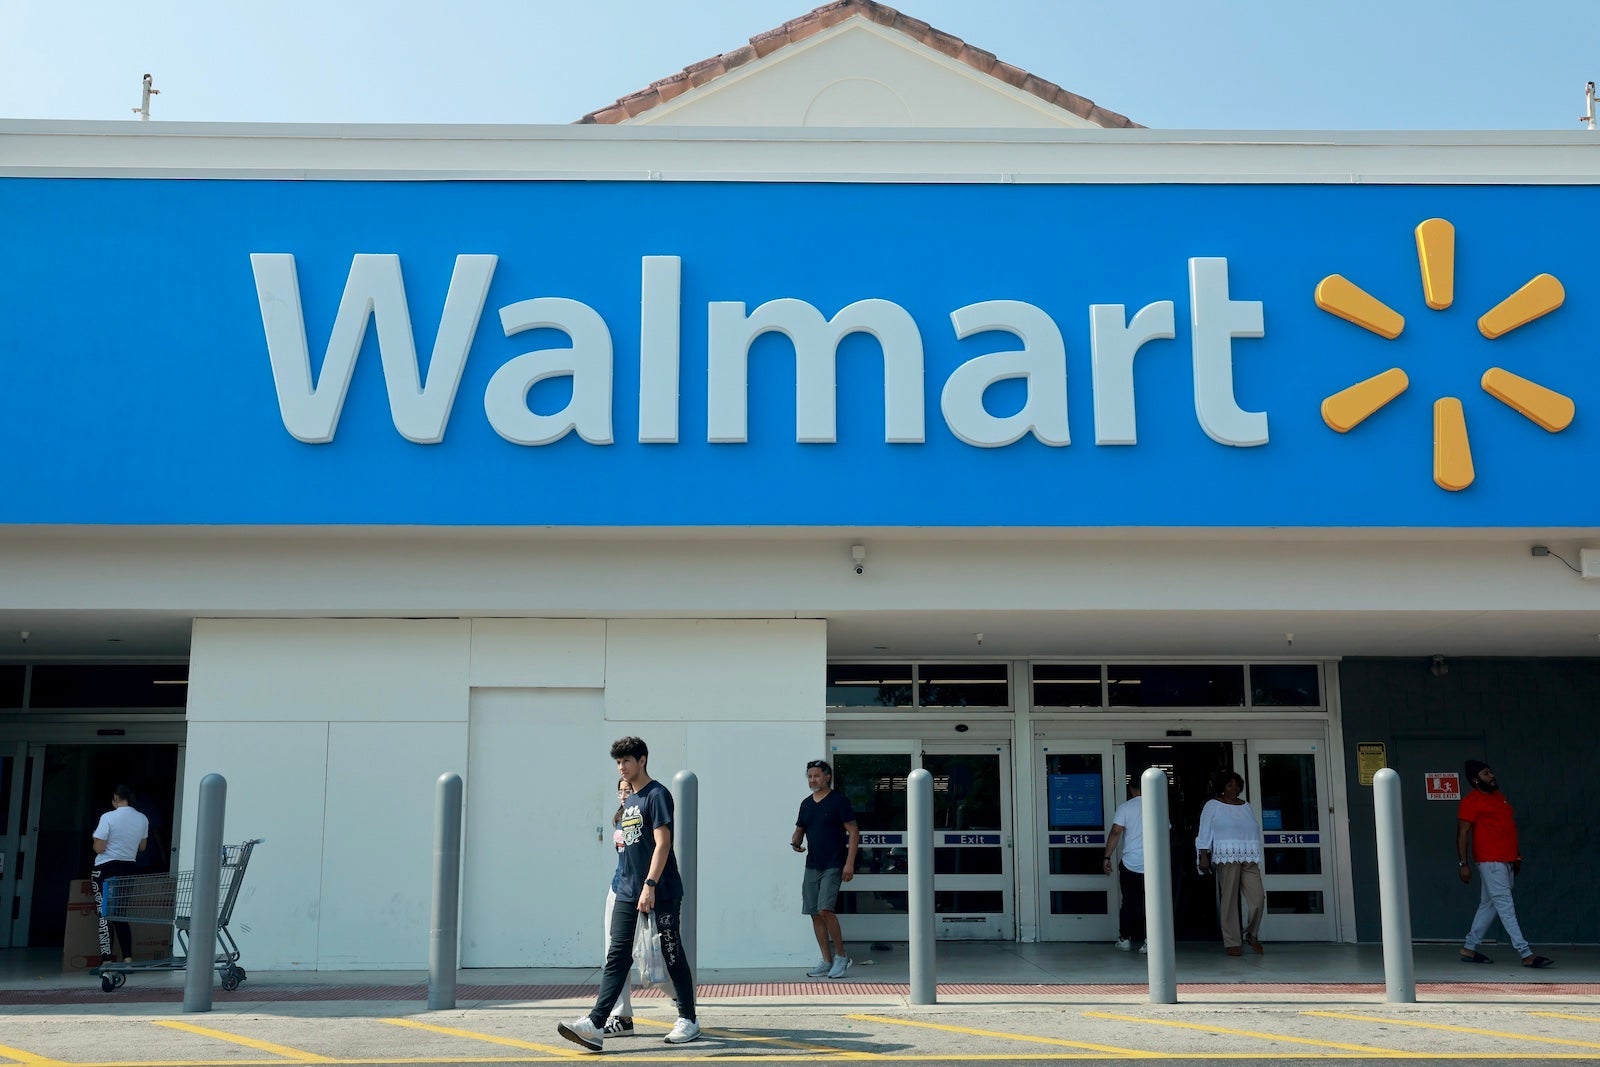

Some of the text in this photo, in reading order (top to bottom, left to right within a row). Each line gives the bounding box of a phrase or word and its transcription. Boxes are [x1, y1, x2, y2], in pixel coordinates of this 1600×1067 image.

[250, 253, 1268, 447] Walmart
[862, 834, 886, 844] Exit
[960, 835, 985, 844] Exit
[1064, 834, 1089, 844] Exit
[1279, 834, 1304, 844] Exit
